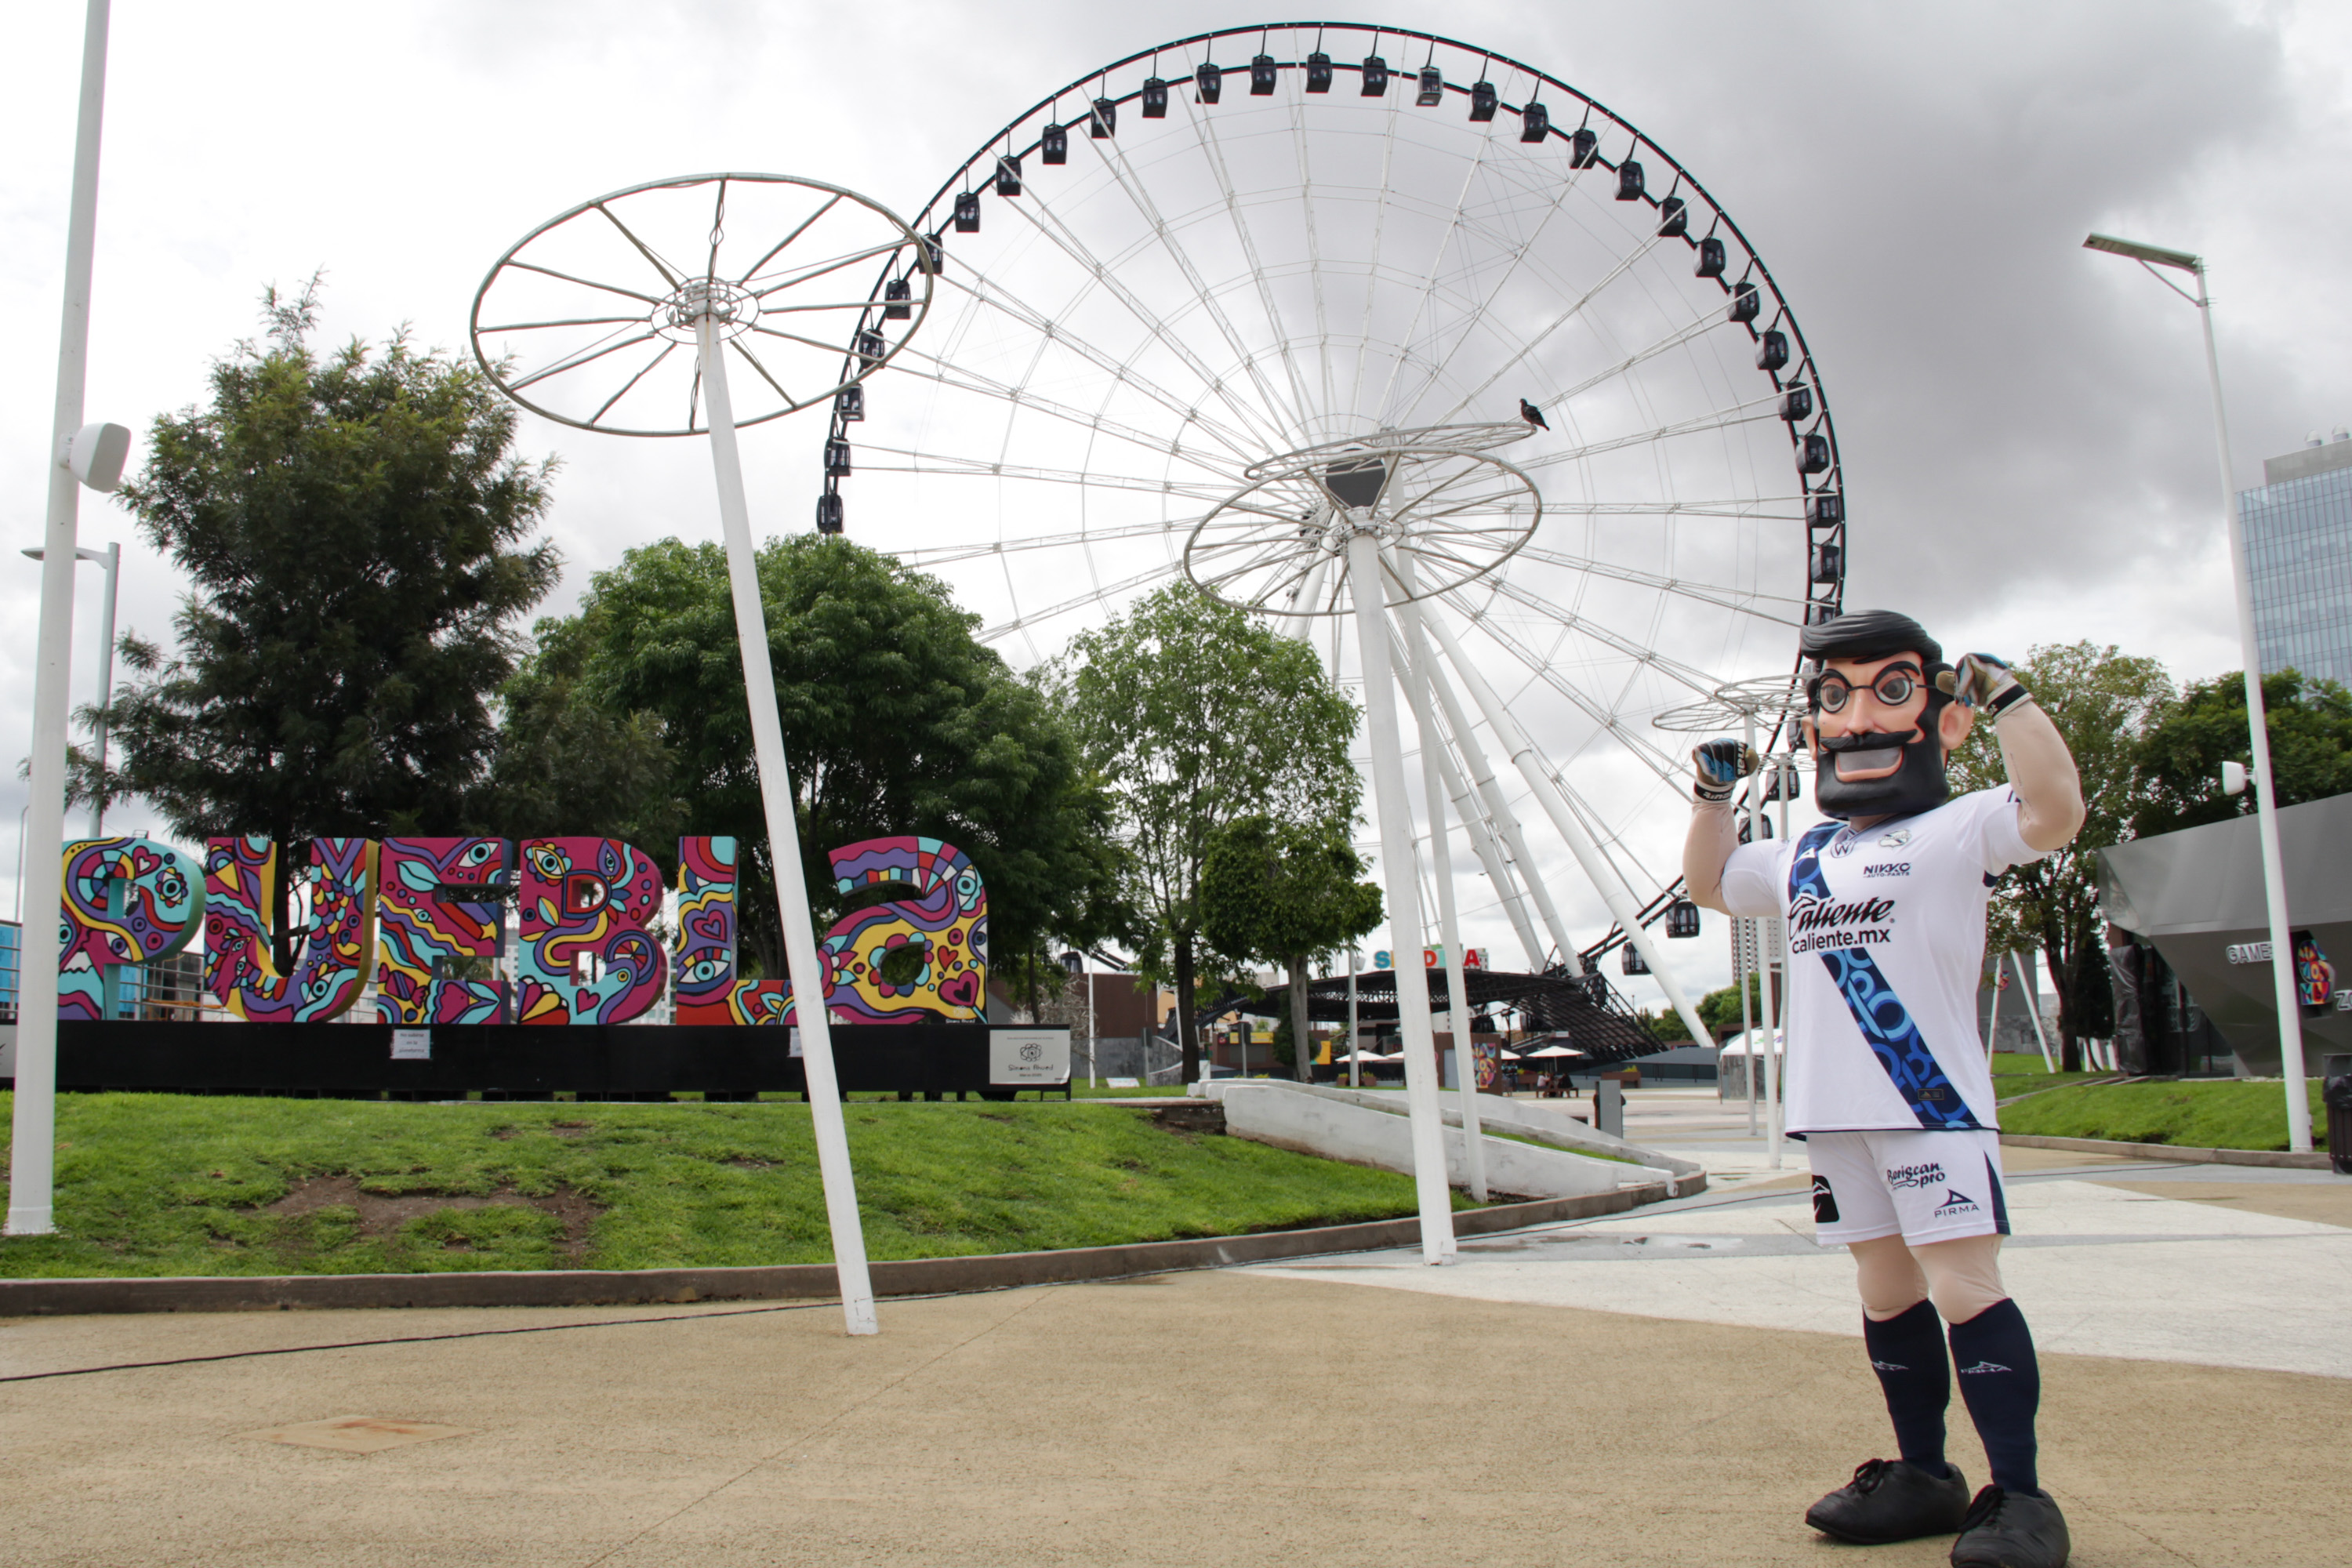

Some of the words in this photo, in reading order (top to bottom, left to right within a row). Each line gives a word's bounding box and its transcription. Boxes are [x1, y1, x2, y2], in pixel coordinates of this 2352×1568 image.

[1864, 862, 1911, 875] NIKKO
[1788, 896, 1895, 941] Caliente
[1792, 929, 1890, 954] caliente.mx
[2226, 941, 2273, 964] GAME
[1887, 1162, 1940, 1185] Beriscan
[1919, 1171, 1946, 1189] pro
[1934, 1203, 1980, 1218] PIRMA
